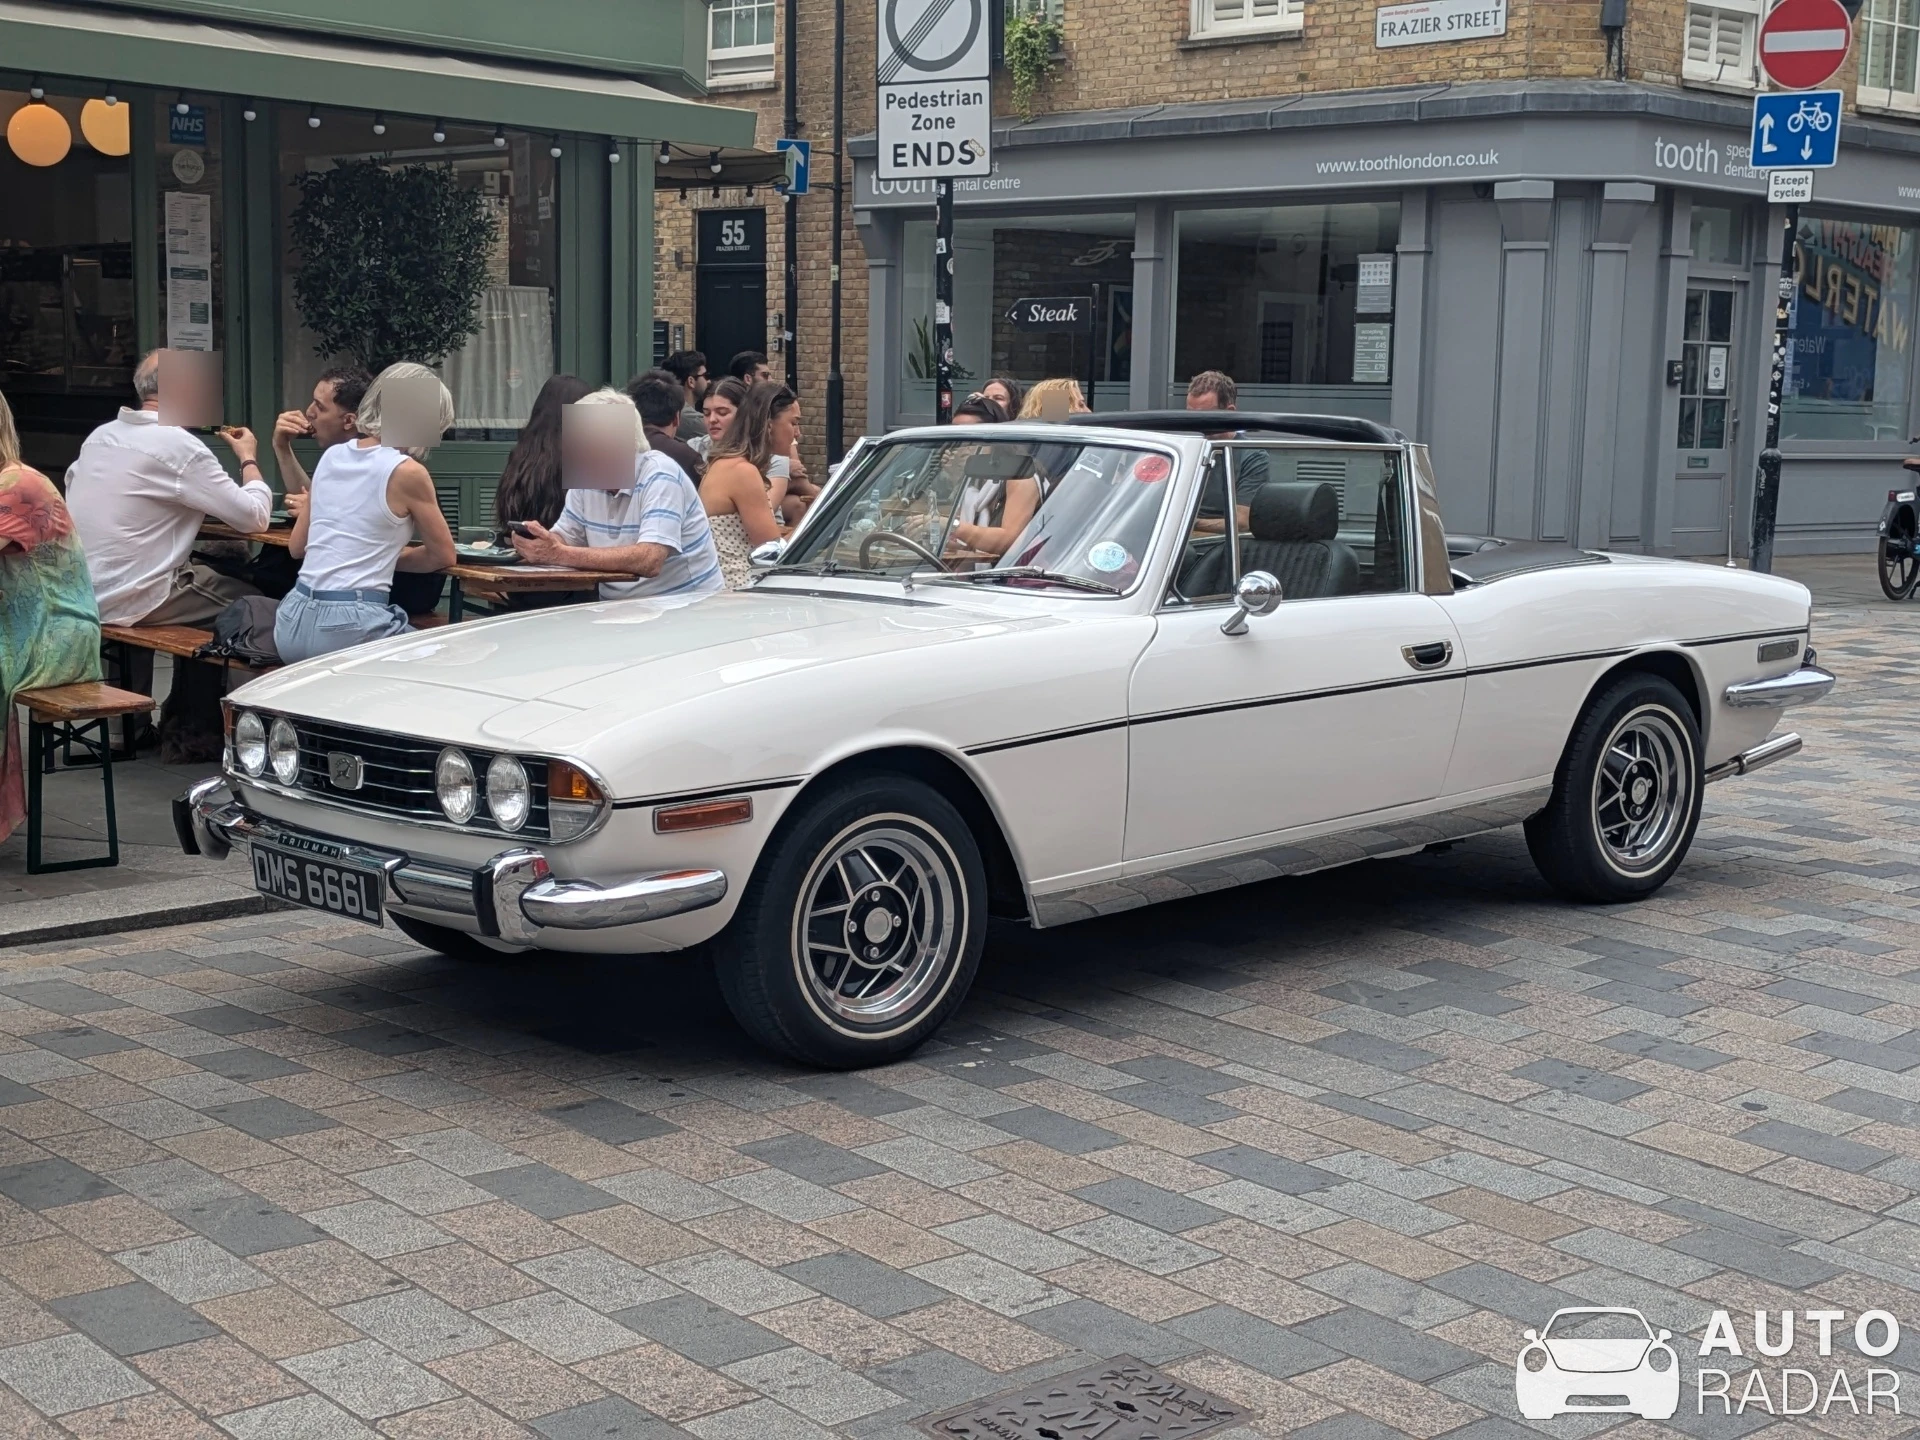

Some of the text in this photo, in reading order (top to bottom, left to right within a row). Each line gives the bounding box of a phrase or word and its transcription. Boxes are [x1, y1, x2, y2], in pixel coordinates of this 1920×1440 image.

[1380, 9, 1502, 38] FRAZIER STREET
[885, 89, 983, 110] Pedestrian
[172, 116, 204, 132] NHS
[911, 114, 956, 131] Zone
[892, 139, 977, 168] ENDS
[1316, 149, 1499, 174] www.toothlondon.co.uk
[1654, 136, 1719, 174] tooth
[952, 177, 1021, 192] ental centre
[1773, 174, 1809, 187] Except
[1773, 187, 1806, 199] cycles
[721, 219, 745, 246] 55
[1028, 303, 1079, 323] Steak
[1375, 341, 1387, 349] £45
[281, 835, 337, 857] TRIUMPH
[253, 847, 379, 921] DMS 666L
